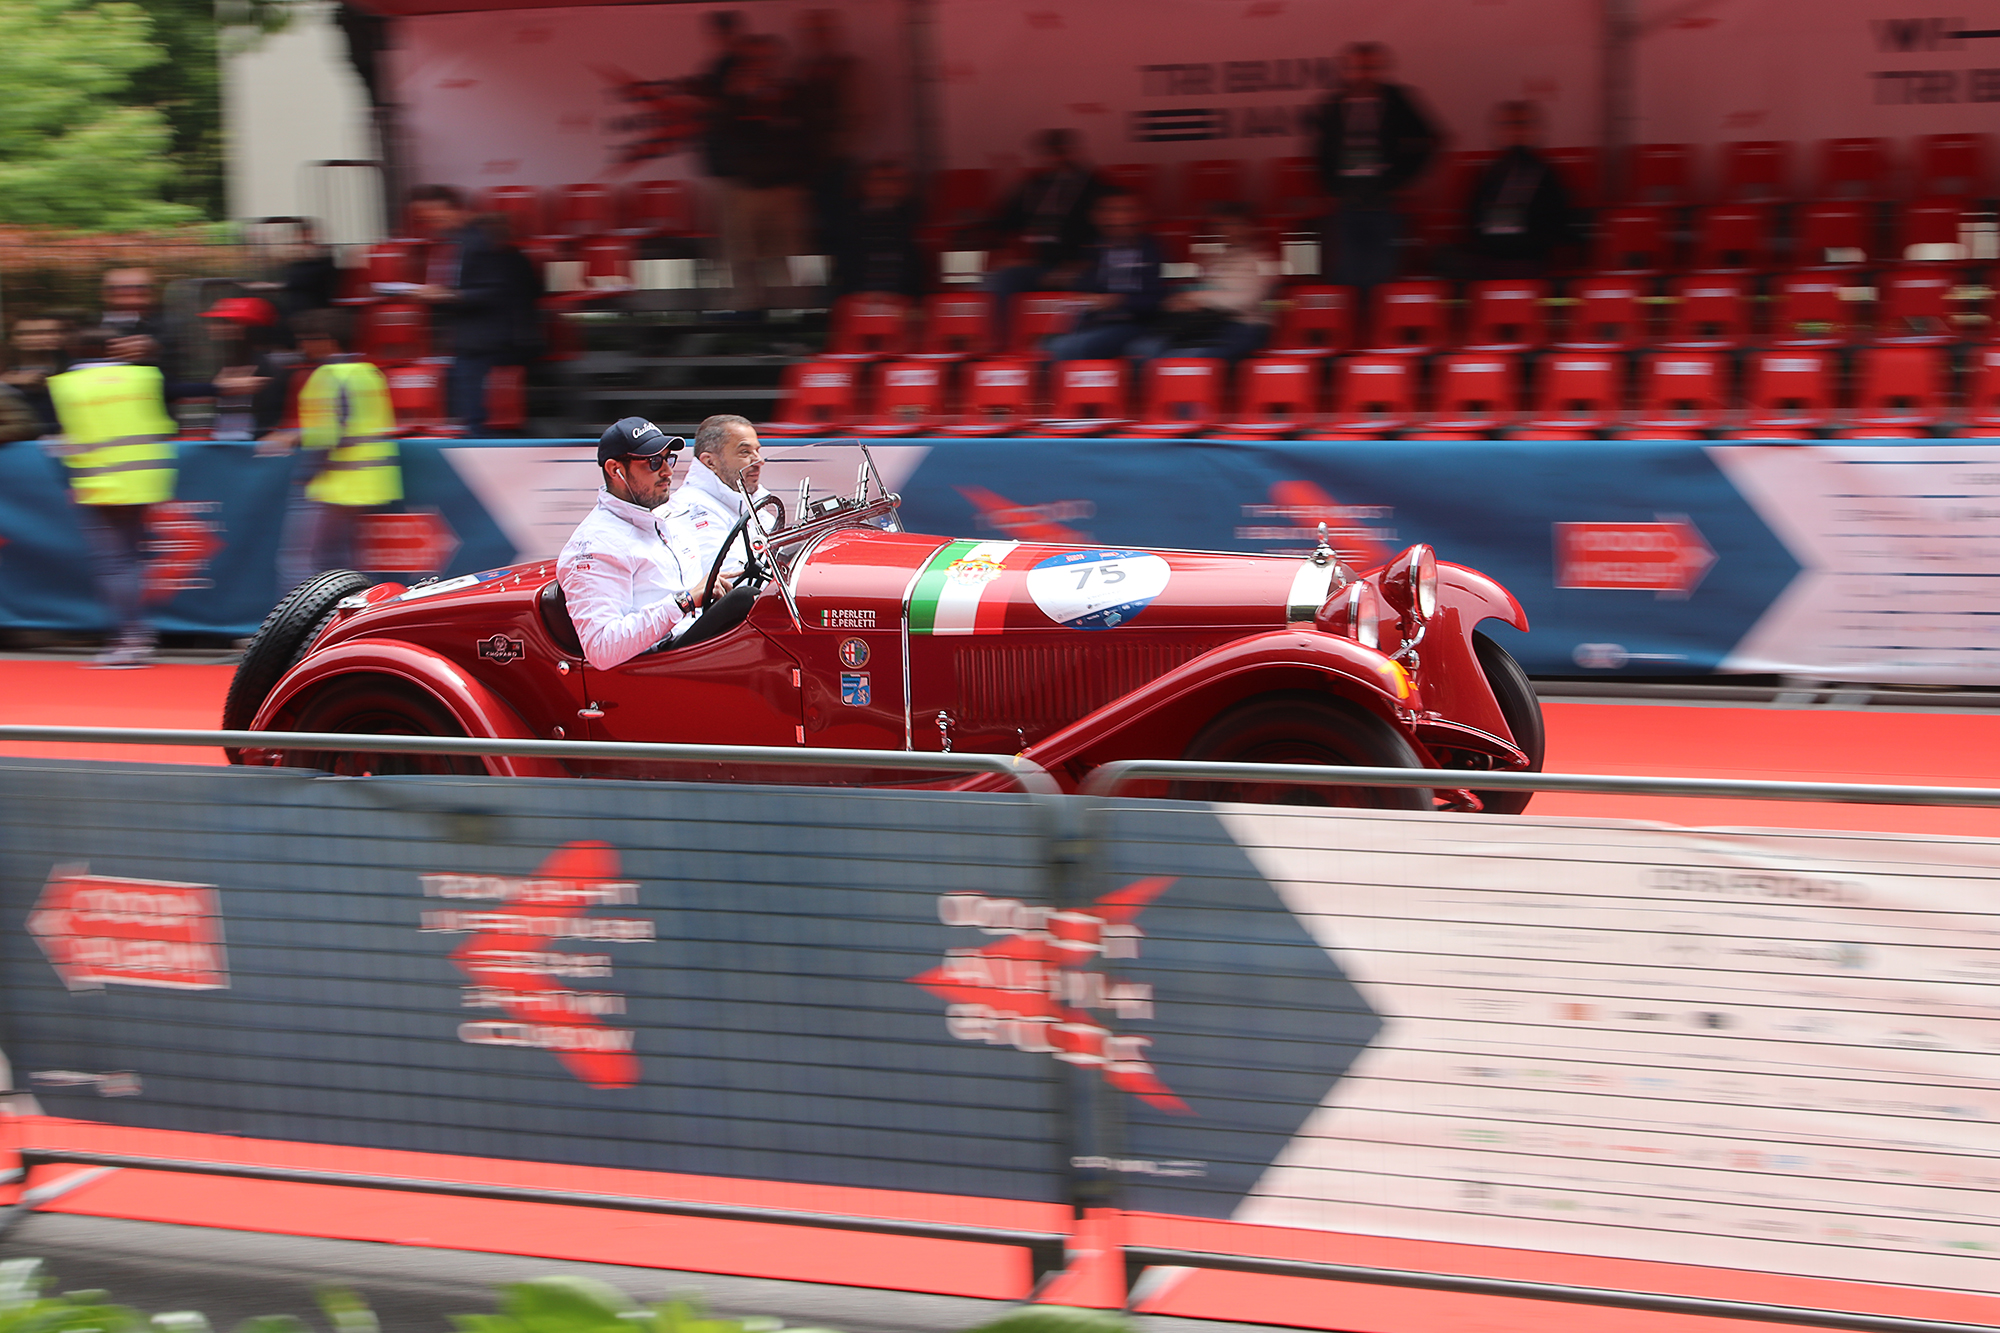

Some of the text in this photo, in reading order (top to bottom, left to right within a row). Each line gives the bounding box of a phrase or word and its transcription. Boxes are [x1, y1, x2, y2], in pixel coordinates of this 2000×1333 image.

[1070, 564, 1126, 590] 75
[831, 609, 876, 619] R.PERLETTI
[831, 619, 876, 628] E.PERLETTI
